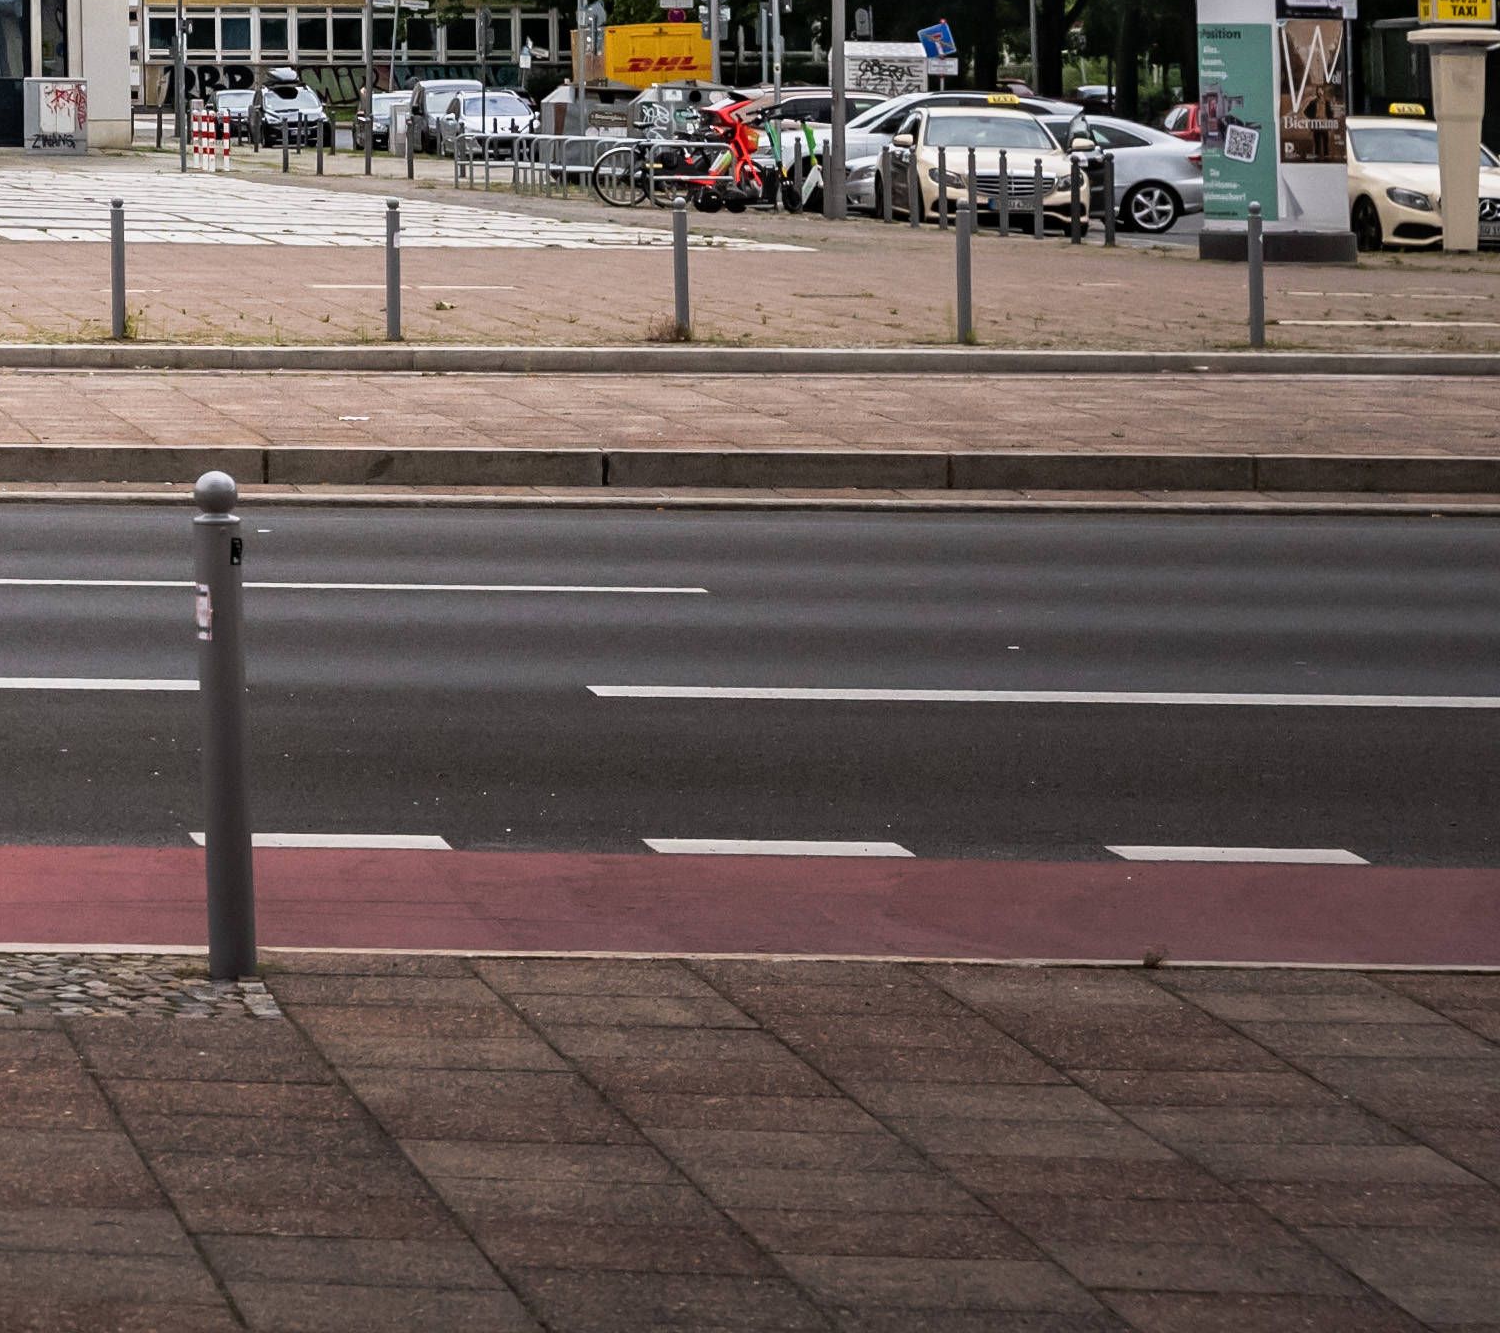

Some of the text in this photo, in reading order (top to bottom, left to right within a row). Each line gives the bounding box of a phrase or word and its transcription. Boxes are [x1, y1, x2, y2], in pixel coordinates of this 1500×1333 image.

[1451, 5, 1478, 17] TAXI
[627, 56, 699, 72] DHL
[1283, 116, 1339, 130] Biermann
